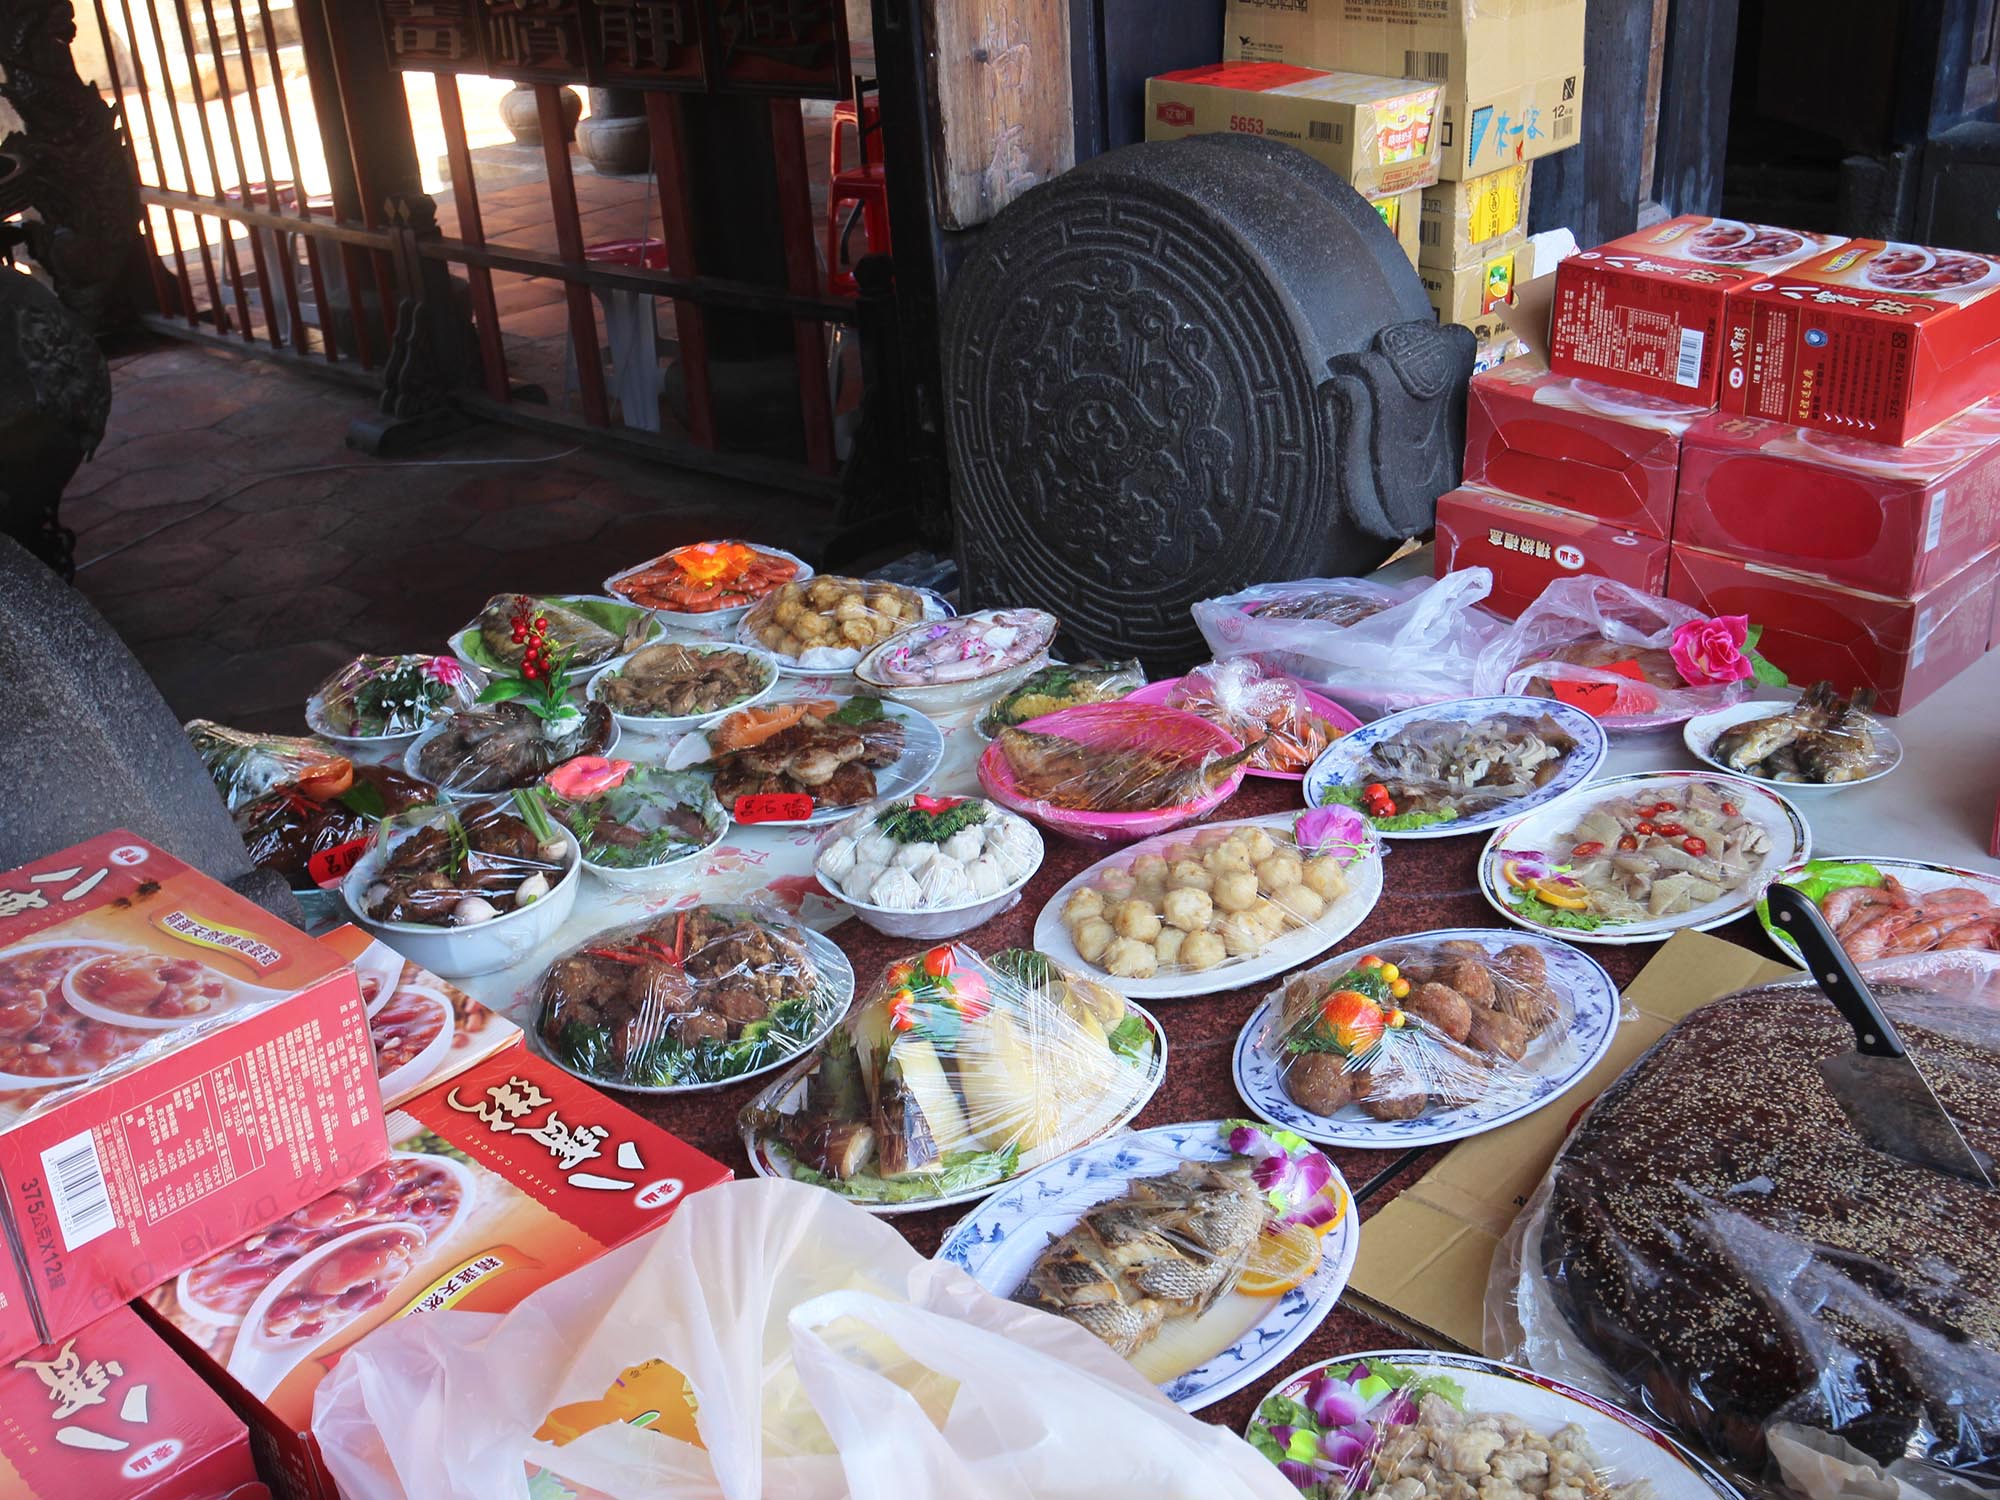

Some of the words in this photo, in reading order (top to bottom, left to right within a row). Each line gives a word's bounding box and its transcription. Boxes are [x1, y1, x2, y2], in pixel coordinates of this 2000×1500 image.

[1230, 115, 1264, 135] 5653
[447, 1076, 645, 1190] 八寶粥
[465, 1134, 513, 1166] CONGEE
[518, 1168, 557, 1195] MIXED
[130, 1443, 174, 1472] 泰山
